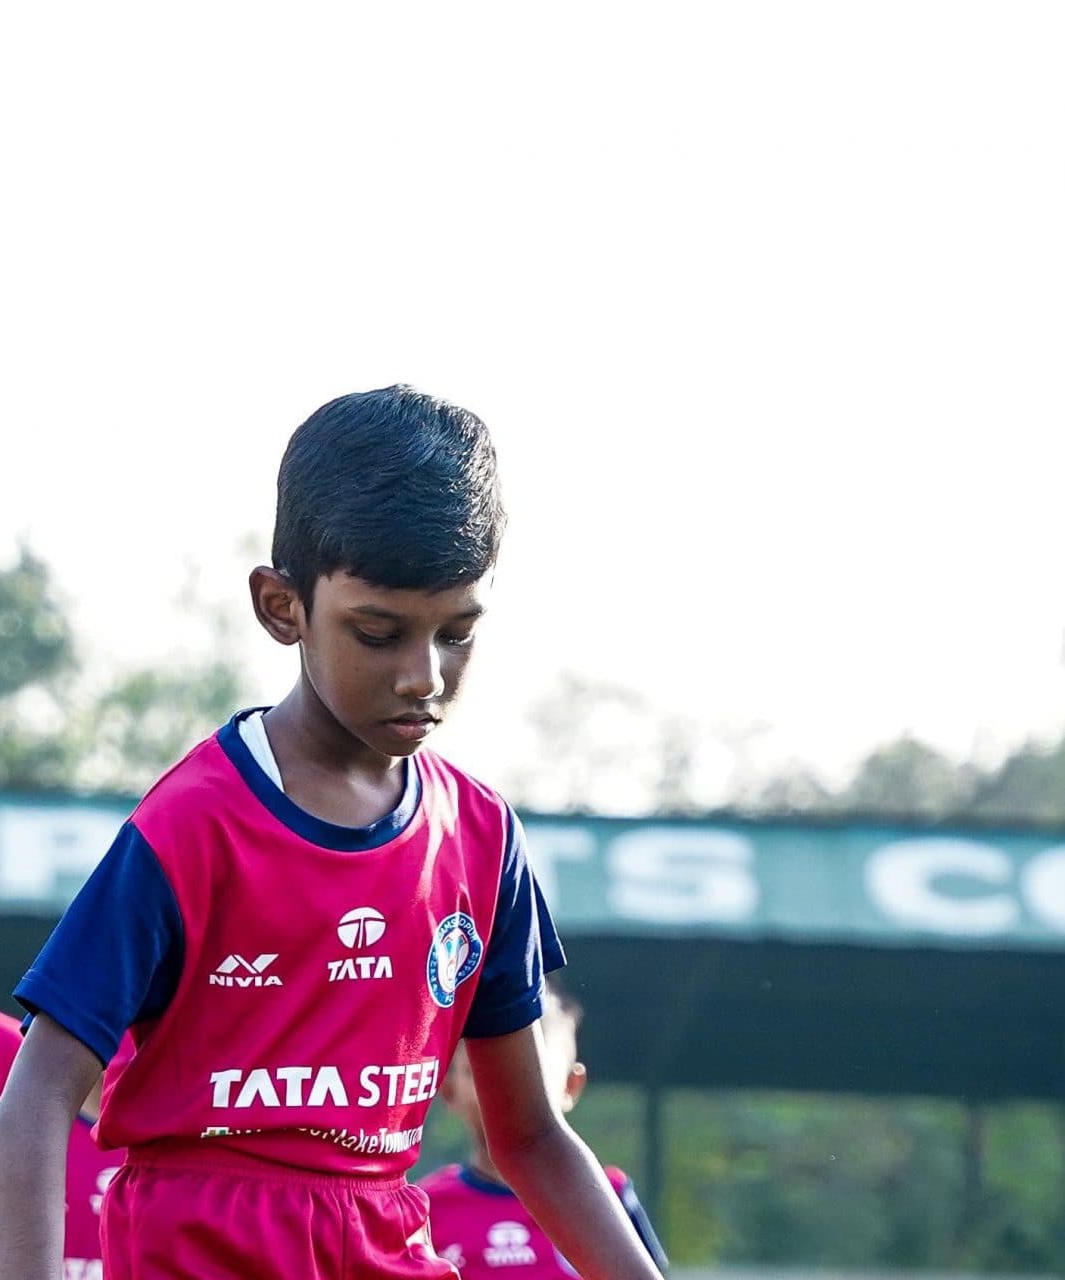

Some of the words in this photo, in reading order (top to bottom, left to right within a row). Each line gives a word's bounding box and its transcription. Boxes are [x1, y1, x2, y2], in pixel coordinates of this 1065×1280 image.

[209, 974, 284, 988] NIVIA
[327, 956, 393, 982] TATA
[210, 1065, 350, 1108] TATA
[357, 1060, 440, 1108] STEEL
